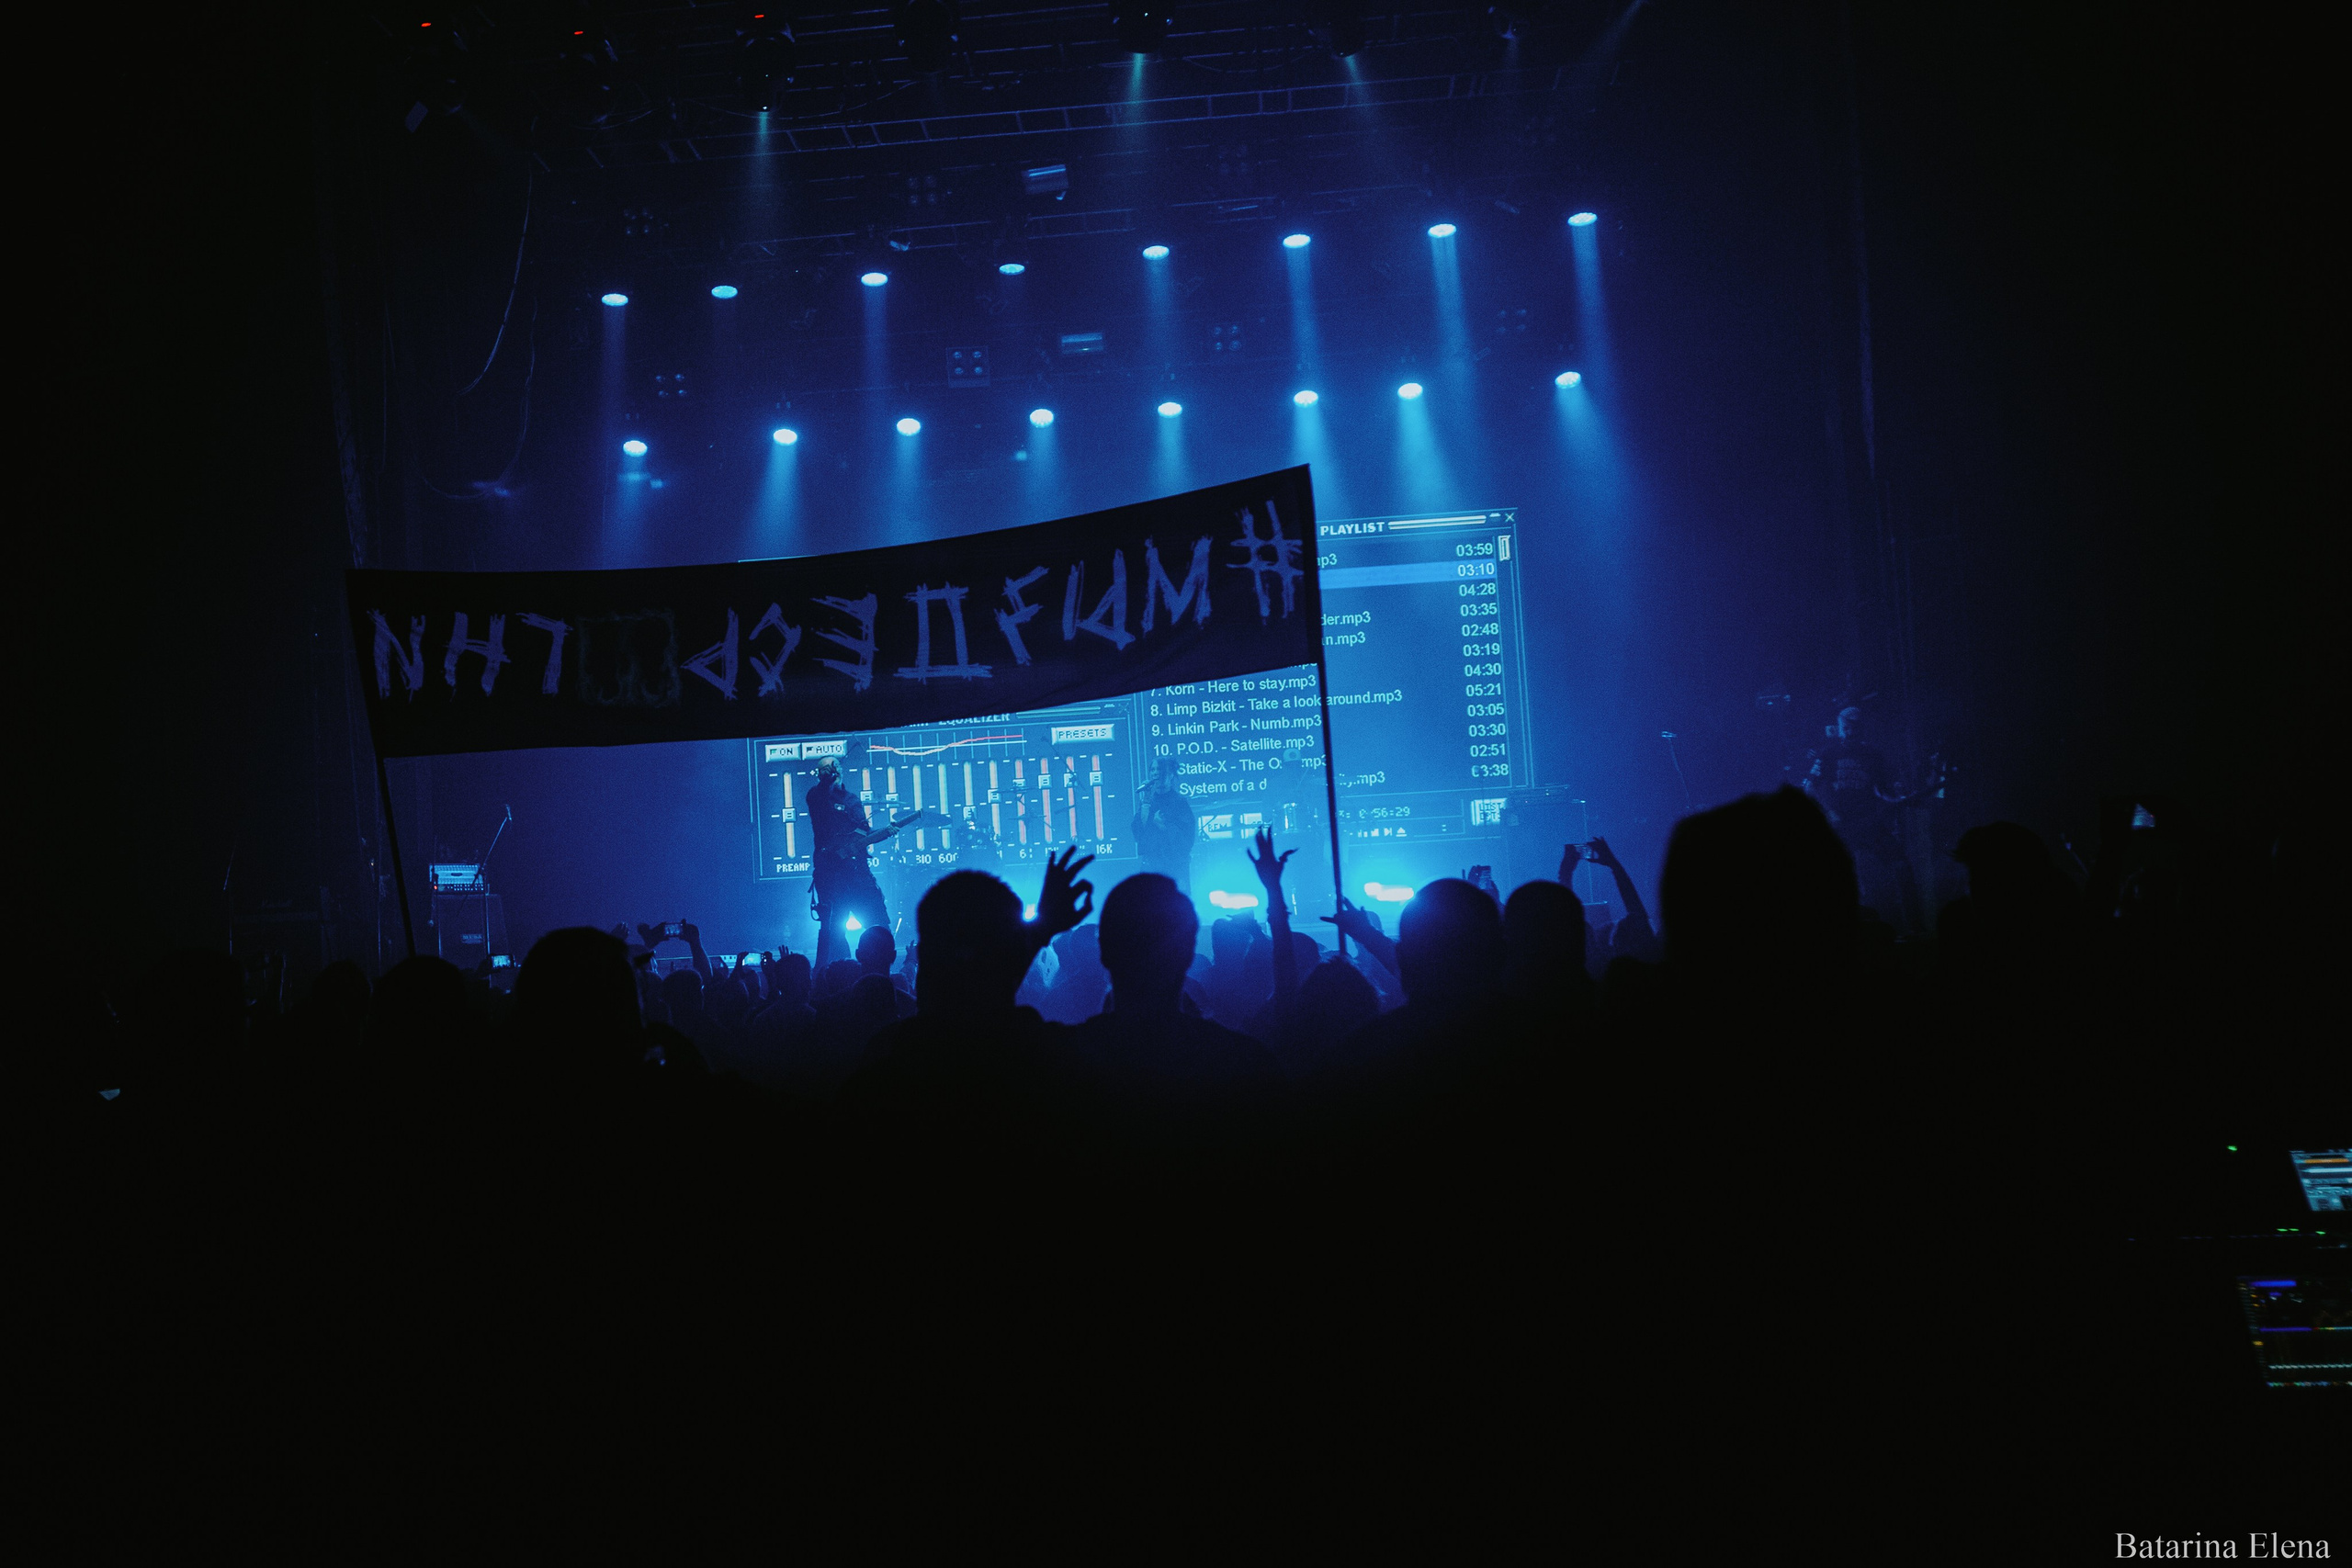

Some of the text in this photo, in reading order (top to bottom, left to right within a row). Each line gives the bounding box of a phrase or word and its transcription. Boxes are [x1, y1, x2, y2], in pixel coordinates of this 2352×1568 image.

[1320, 522, 1385, 536] PLAYLIST
[1456, 543, 1493, 557] 03:59
[1457, 562, 1495, 577] 03:10
[1459, 582, 1496, 596] 04:28
[1460, 603, 1498, 616] 03:35
[1322, 623, 1498, 647] n.mp3 02:48
[1463, 643, 1500, 657] 03:19
[1207, 681, 1239, 694] Here
[1242, 680, 1255, 692] to
[1259, 674, 1317, 691] stay.mp3
[1464, 662, 1501, 677] 04:30
[1150, 705, 1163, 716] 8.
[1167, 703, 1197, 716] Limp
[1202, 700, 1236, 714] Bizkit
[1248, 697, 1279, 711] Take
[1283, 699, 1291, 709] a
[1294, 694, 1321, 708] look
[1327, 689, 1403, 705] around.mp3
[1466, 682, 1502, 697] 05:21
[1151, 724, 1164, 737] 9.
[1168, 722, 1204, 736] Linkin
[1209, 720, 1239, 733] Park
[1250, 715, 1322, 730] Numb.mp3
[1467, 703, 1505, 717] 03:05
[1057, 728, 1107, 739] PRESETS
[1154, 743, 1173, 756] 10.
[1177, 741, 1218, 755] P.O.D.
[1231, 735, 1315, 752] Satellite.mp3
[1469, 723, 1506, 738] 03:30
[779, 748, 793, 756] ON
[816, 744, 842, 754] AUTO
[1177, 761, 1227, 775] Static-X
[1239, 759, 1264, 772] The
[1470, 743, 1506, 758] 02:51
[1179, 783, 1227, 797] System
[1231, 780, 1244, 792] of
[1247, 781, 1255, 791] a
[776, 862, 810, 873] PREAMP
[1096, 843, 1113, 854] 16K
